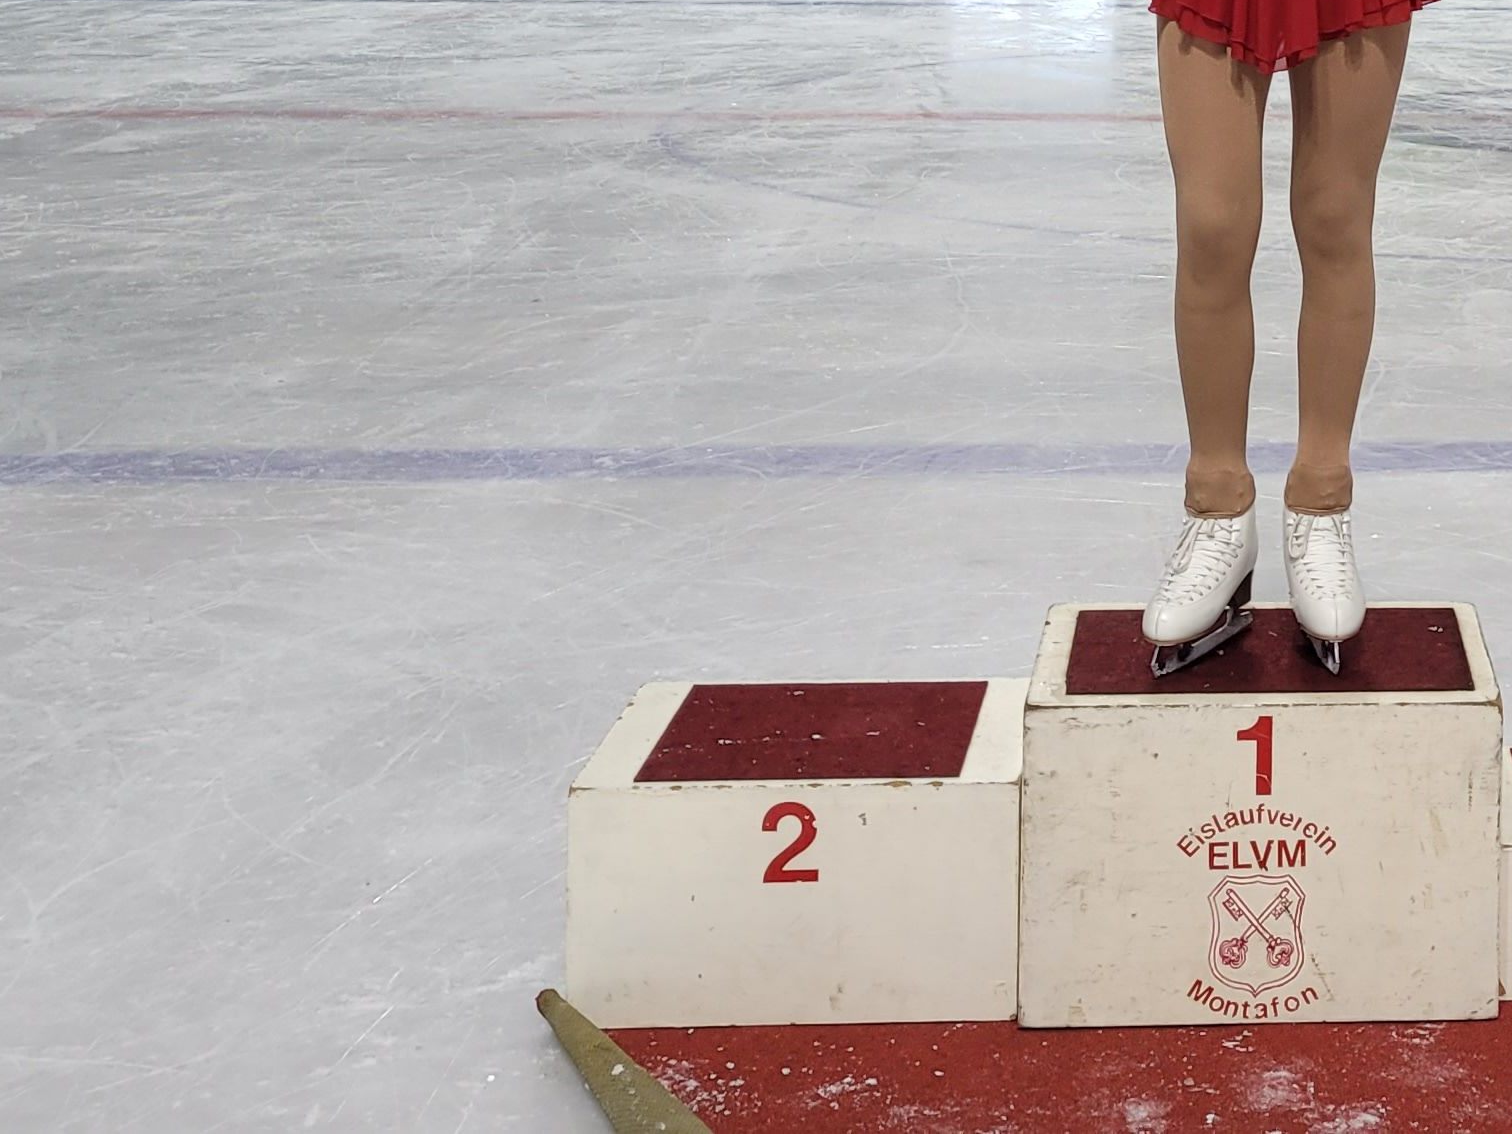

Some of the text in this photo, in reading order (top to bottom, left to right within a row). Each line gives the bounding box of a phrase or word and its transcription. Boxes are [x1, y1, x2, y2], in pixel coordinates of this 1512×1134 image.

[1236, 715, 1273, 796] 1
[761, 801, 819, 883] 2
[1176, 803, 1338, 858] Eislaufverein
[1208, 839, 1307, 870] ELVM
[1187, 979, 1319, 1019] Montafon
